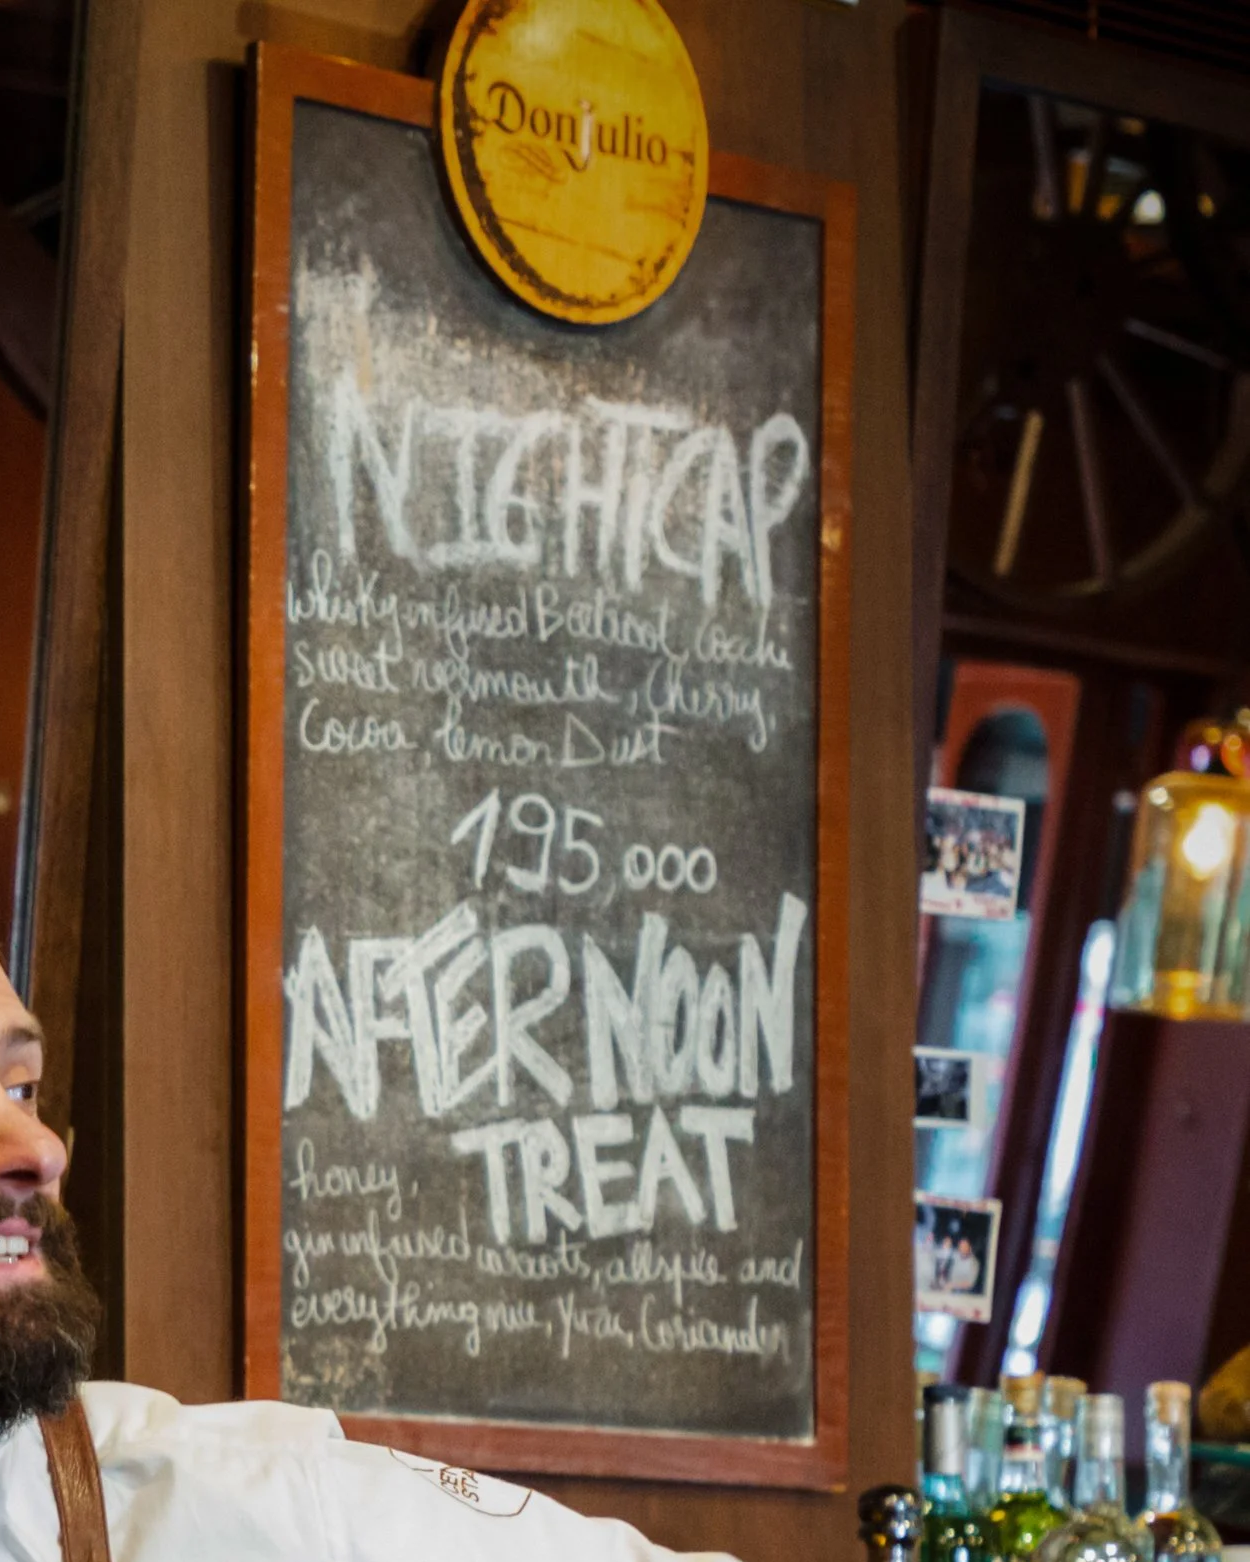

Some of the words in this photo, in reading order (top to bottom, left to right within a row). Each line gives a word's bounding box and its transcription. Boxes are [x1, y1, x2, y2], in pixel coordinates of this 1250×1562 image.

[329, 378, 810, 608] NIGHTCAP
[561, 711, 682, 768] Dust
[453, 1106, 754, 1243] TREAT
[740, 1238, 803, 1290] and
